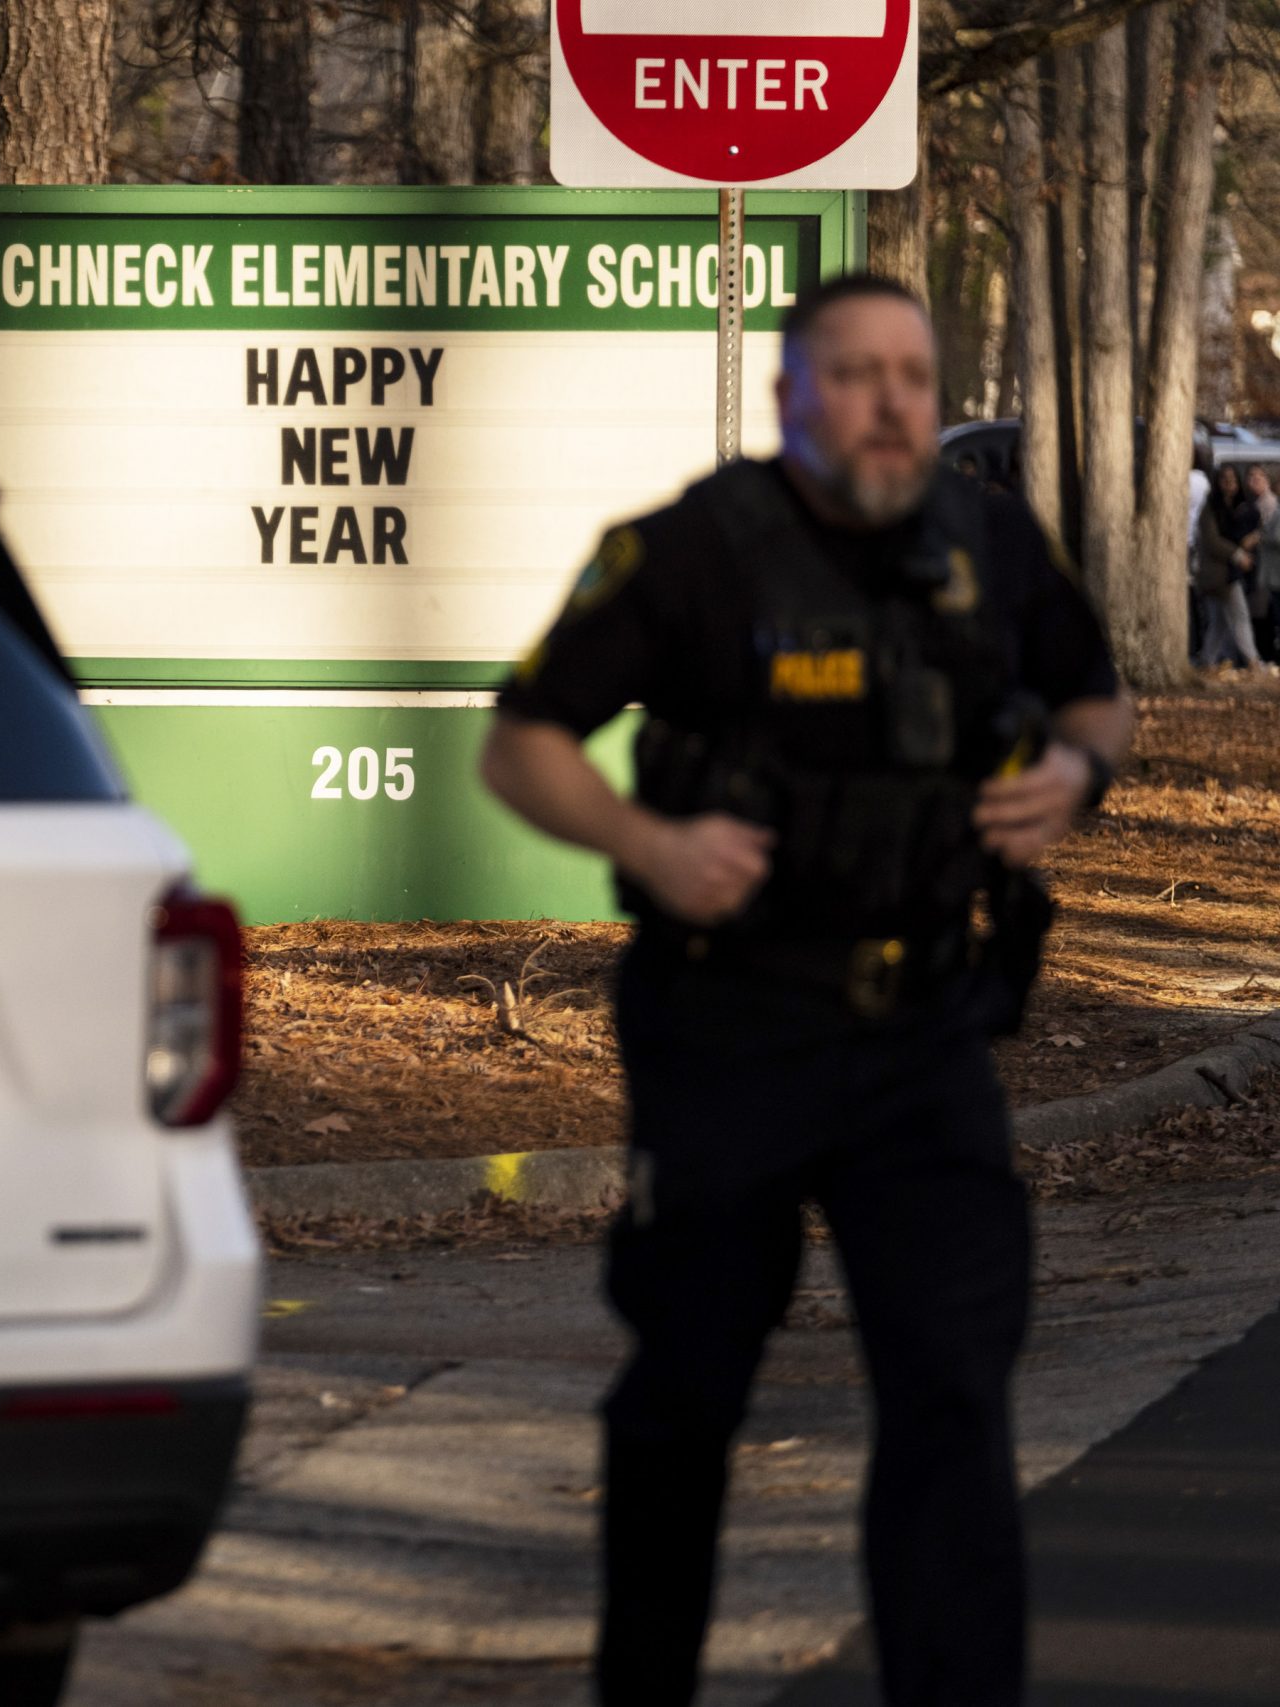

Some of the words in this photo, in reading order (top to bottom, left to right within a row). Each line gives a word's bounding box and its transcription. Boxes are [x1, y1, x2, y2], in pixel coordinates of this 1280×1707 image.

[634, 57, 829, 111] ENTER
[230, 244, 570, 307] ELEMENTARY
[586, 243, 797, 309] SCHOOL
[246, 347, 444, 406] HAPPY
[281, 426, 415, 486] NEW
[252, 506, 409, 565] YEAR
[310, 745, 415, 801] 205
